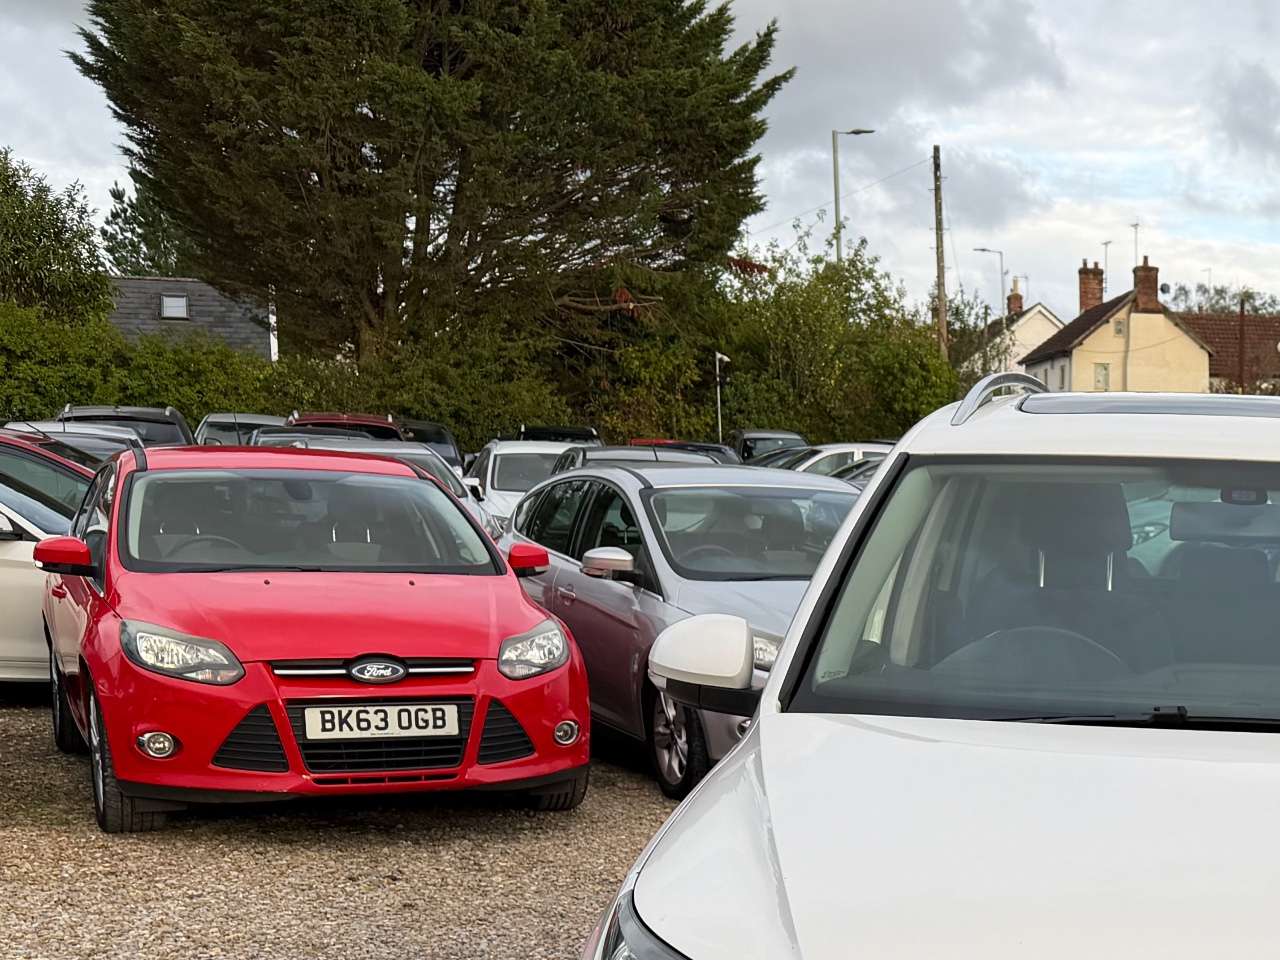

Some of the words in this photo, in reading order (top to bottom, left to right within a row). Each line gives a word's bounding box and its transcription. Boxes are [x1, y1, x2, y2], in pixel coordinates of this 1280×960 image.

[364, 664, 393, 678] Ford
[319, 709, 390, 733] BK63
[396, 707, 447, 731] OGB
